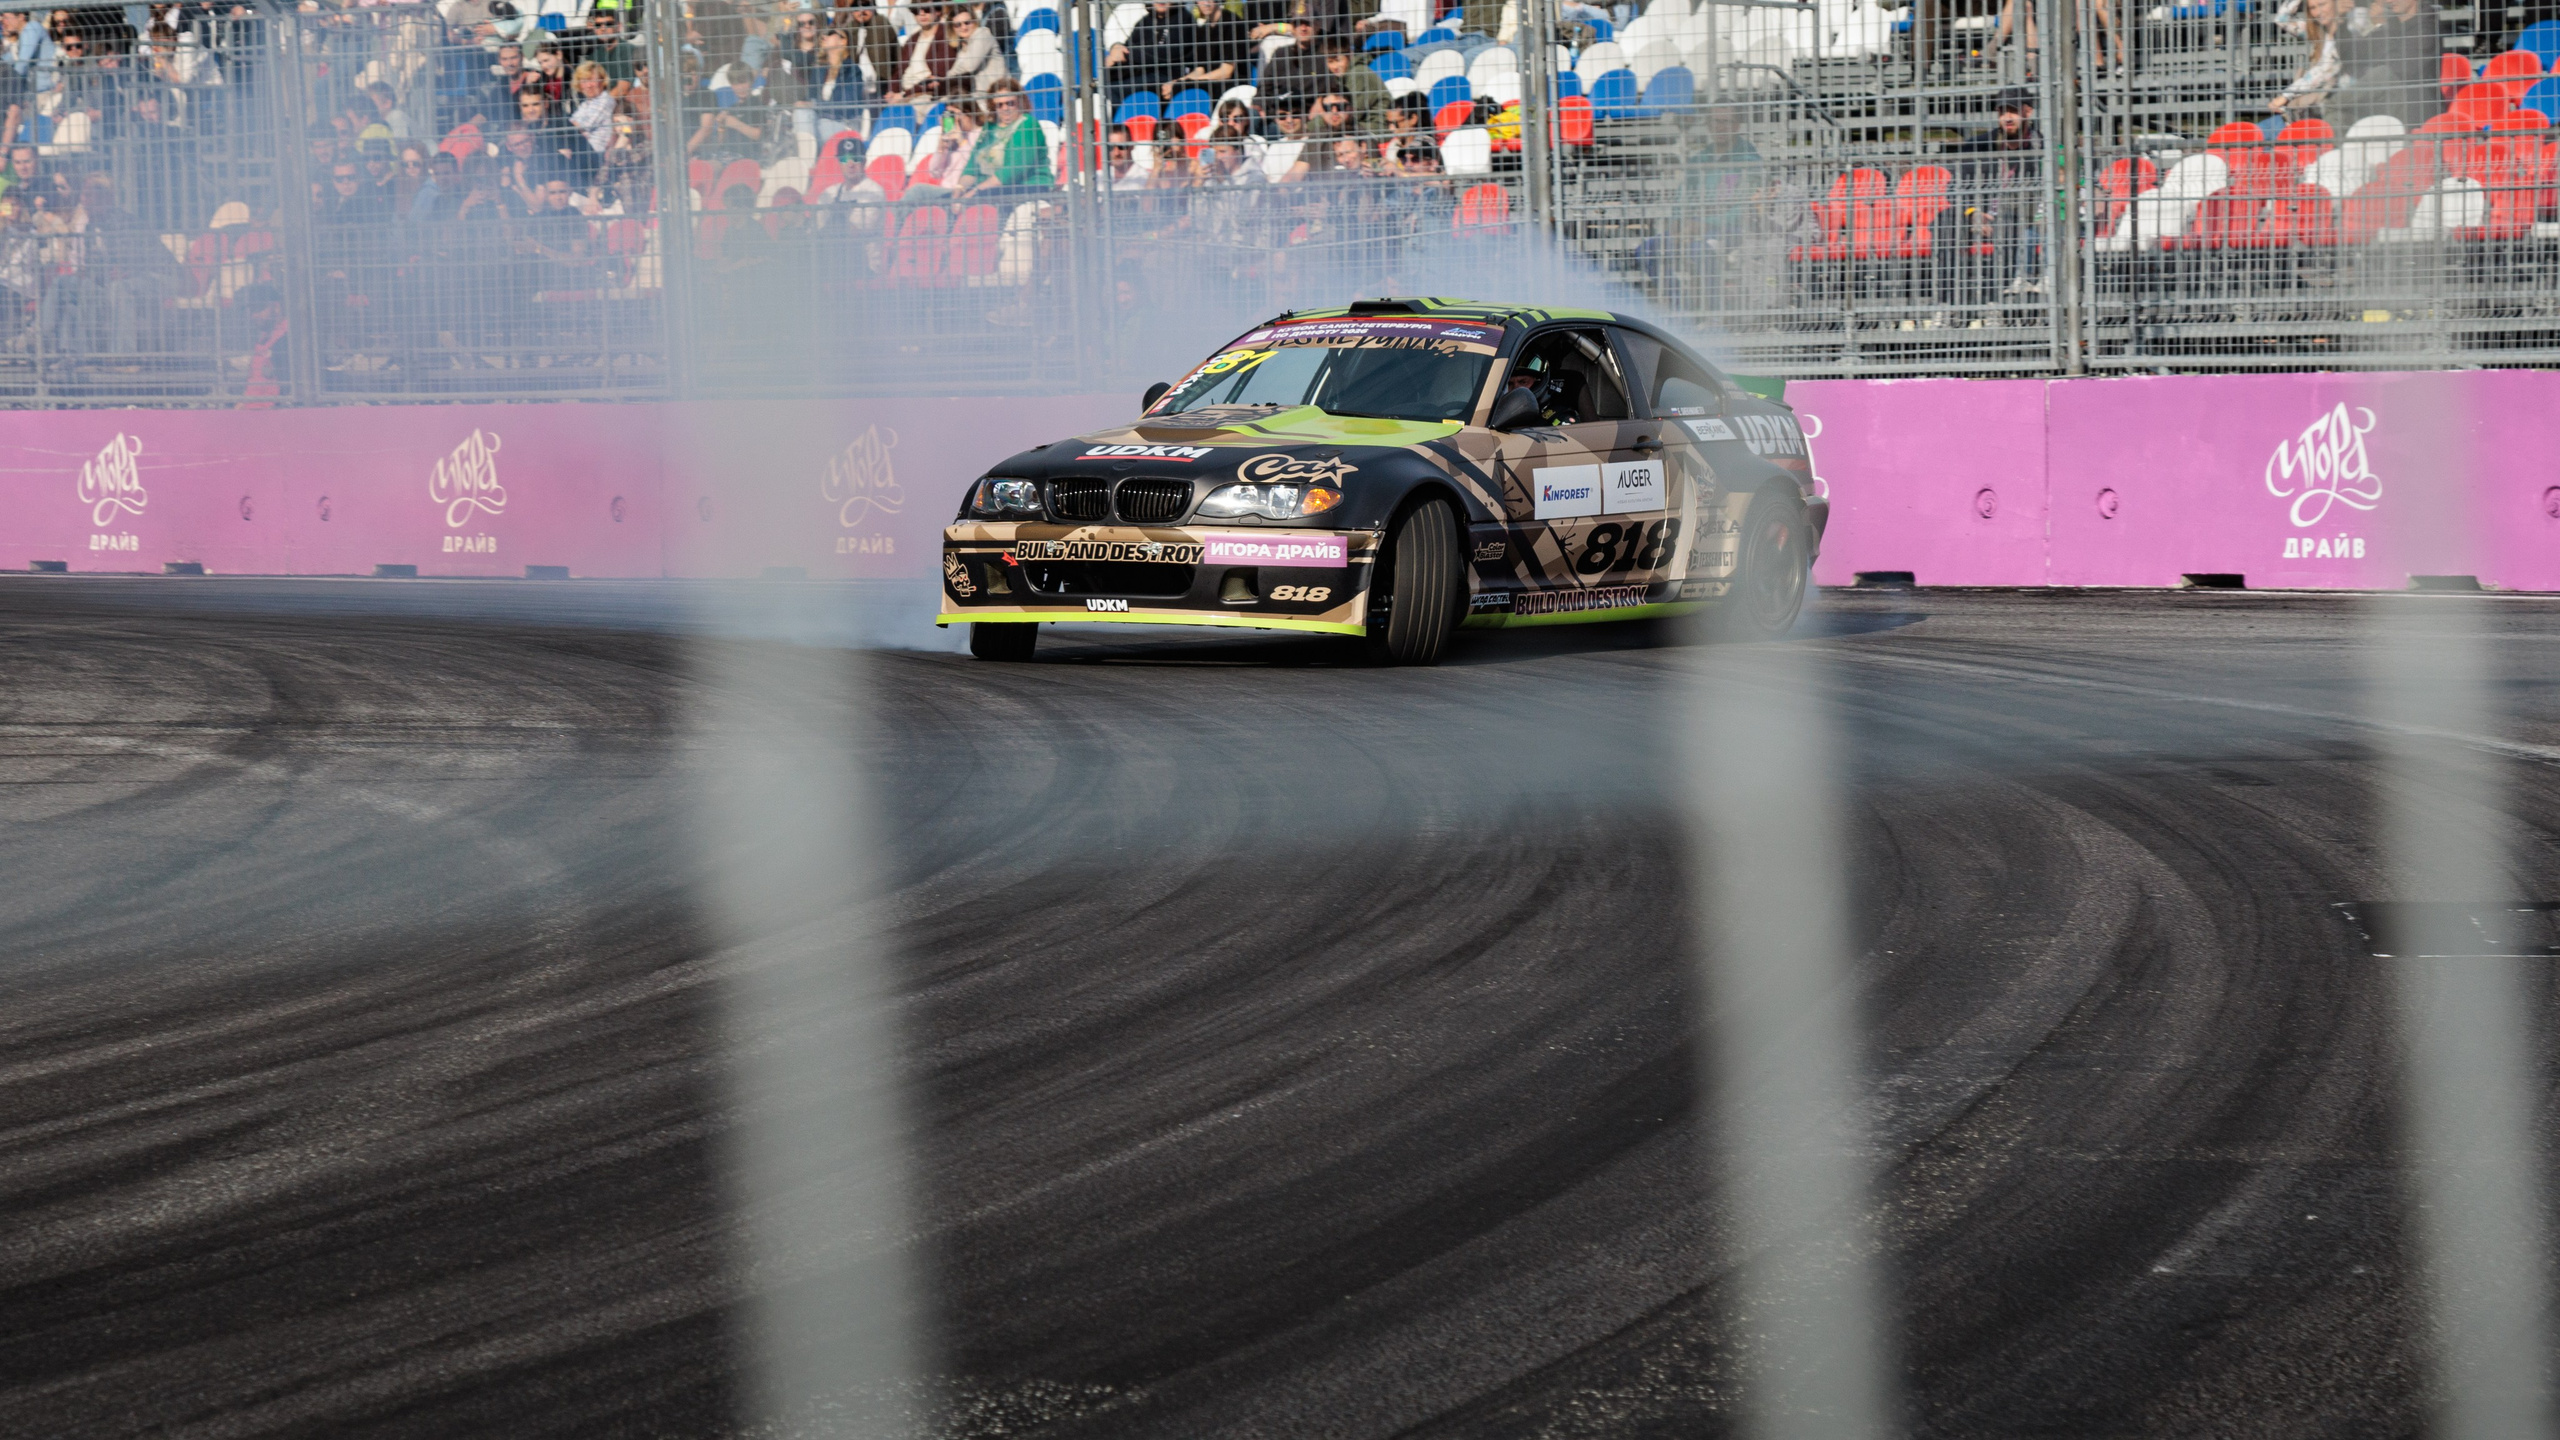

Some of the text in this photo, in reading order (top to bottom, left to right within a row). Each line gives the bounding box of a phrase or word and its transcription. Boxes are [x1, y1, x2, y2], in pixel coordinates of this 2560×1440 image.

[1277, 322, 1432, 333] КУБОК САНКТ-ПЕТЕРБУРГА
[1289, 330, 1338, 338] ДРИФТУ
[1734, 415, 1805, 456] UDKM
[1086, 445, 1214, 459] UDKM
[1617, 469, 1652, 489] AUGER
[1543, 485, 1590, 501] KINFOREST
[88, 531, 140, 551] ДРАЙВ
[442, 532, 497, 553] ДРАЙВ
[835, 533, 895, 554] ДРАЙВ
[1211, 542, 1341, 560] ИГОРА ДРАЙВ
[1488, 543, 1505, 551] Color
[1576, 517, 1682, 575] 818
[2282, 533, 2366, 559] ДРАЙВ
[1015, 541, 1204, 564] BUILD AND DESTROY
[1270, 585, 1331, 602] 818
[1515, 585, 1649, 616] BUILD AND DESTROY
[1086, 598, 1128, 612] UDKM
